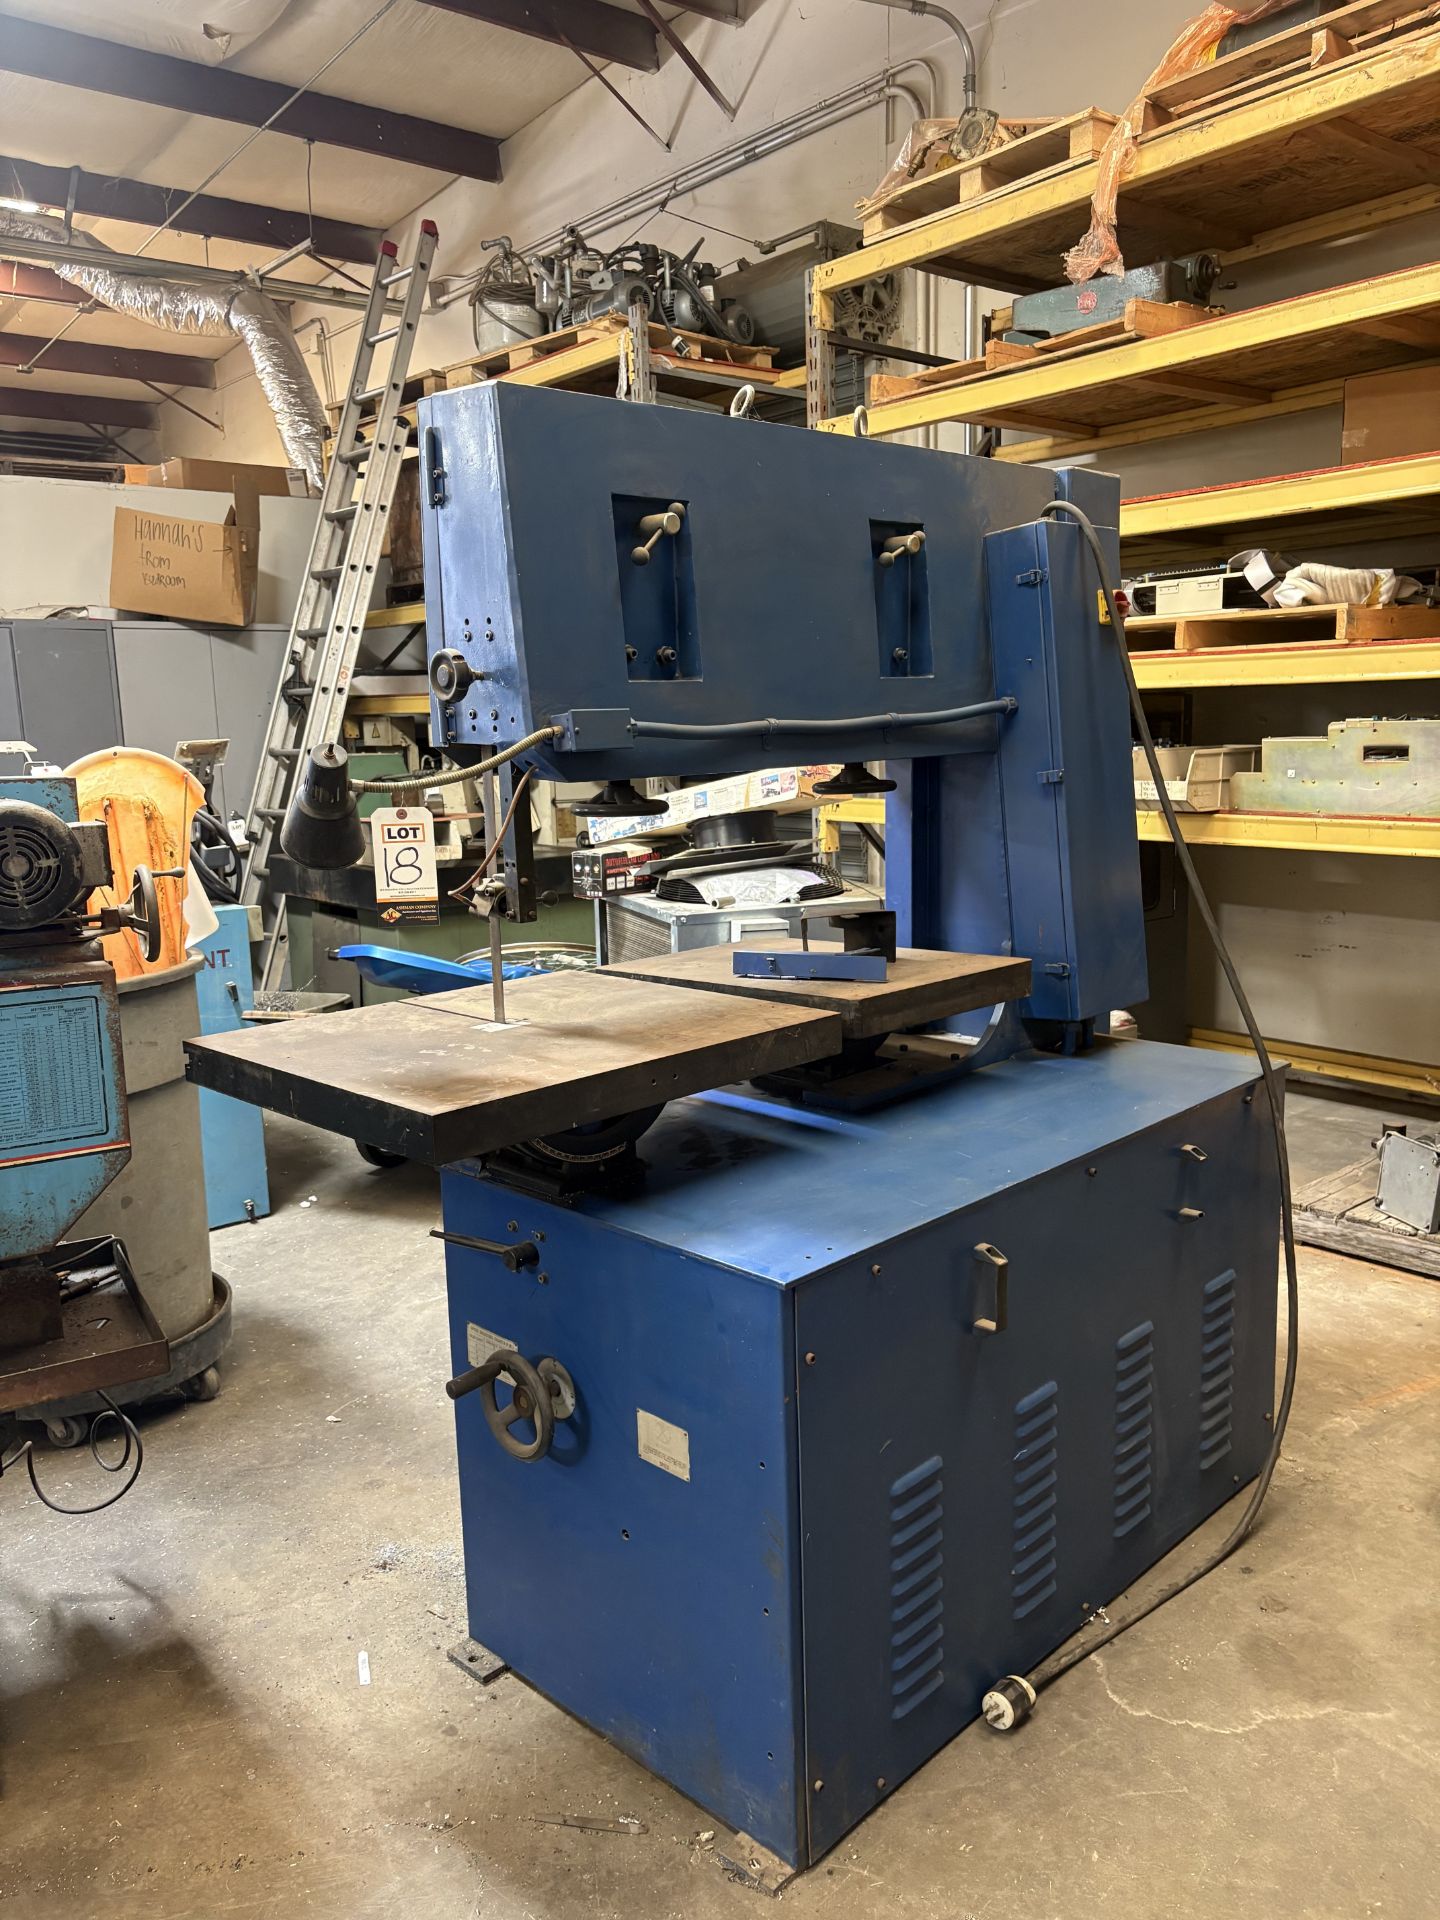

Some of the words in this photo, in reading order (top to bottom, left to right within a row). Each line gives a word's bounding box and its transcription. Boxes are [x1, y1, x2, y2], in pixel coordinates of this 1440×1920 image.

[134, 515, 205, 552] Hannah's
[387, 827, 420, 839] LOT
[383, 846, 422, 888] 18
